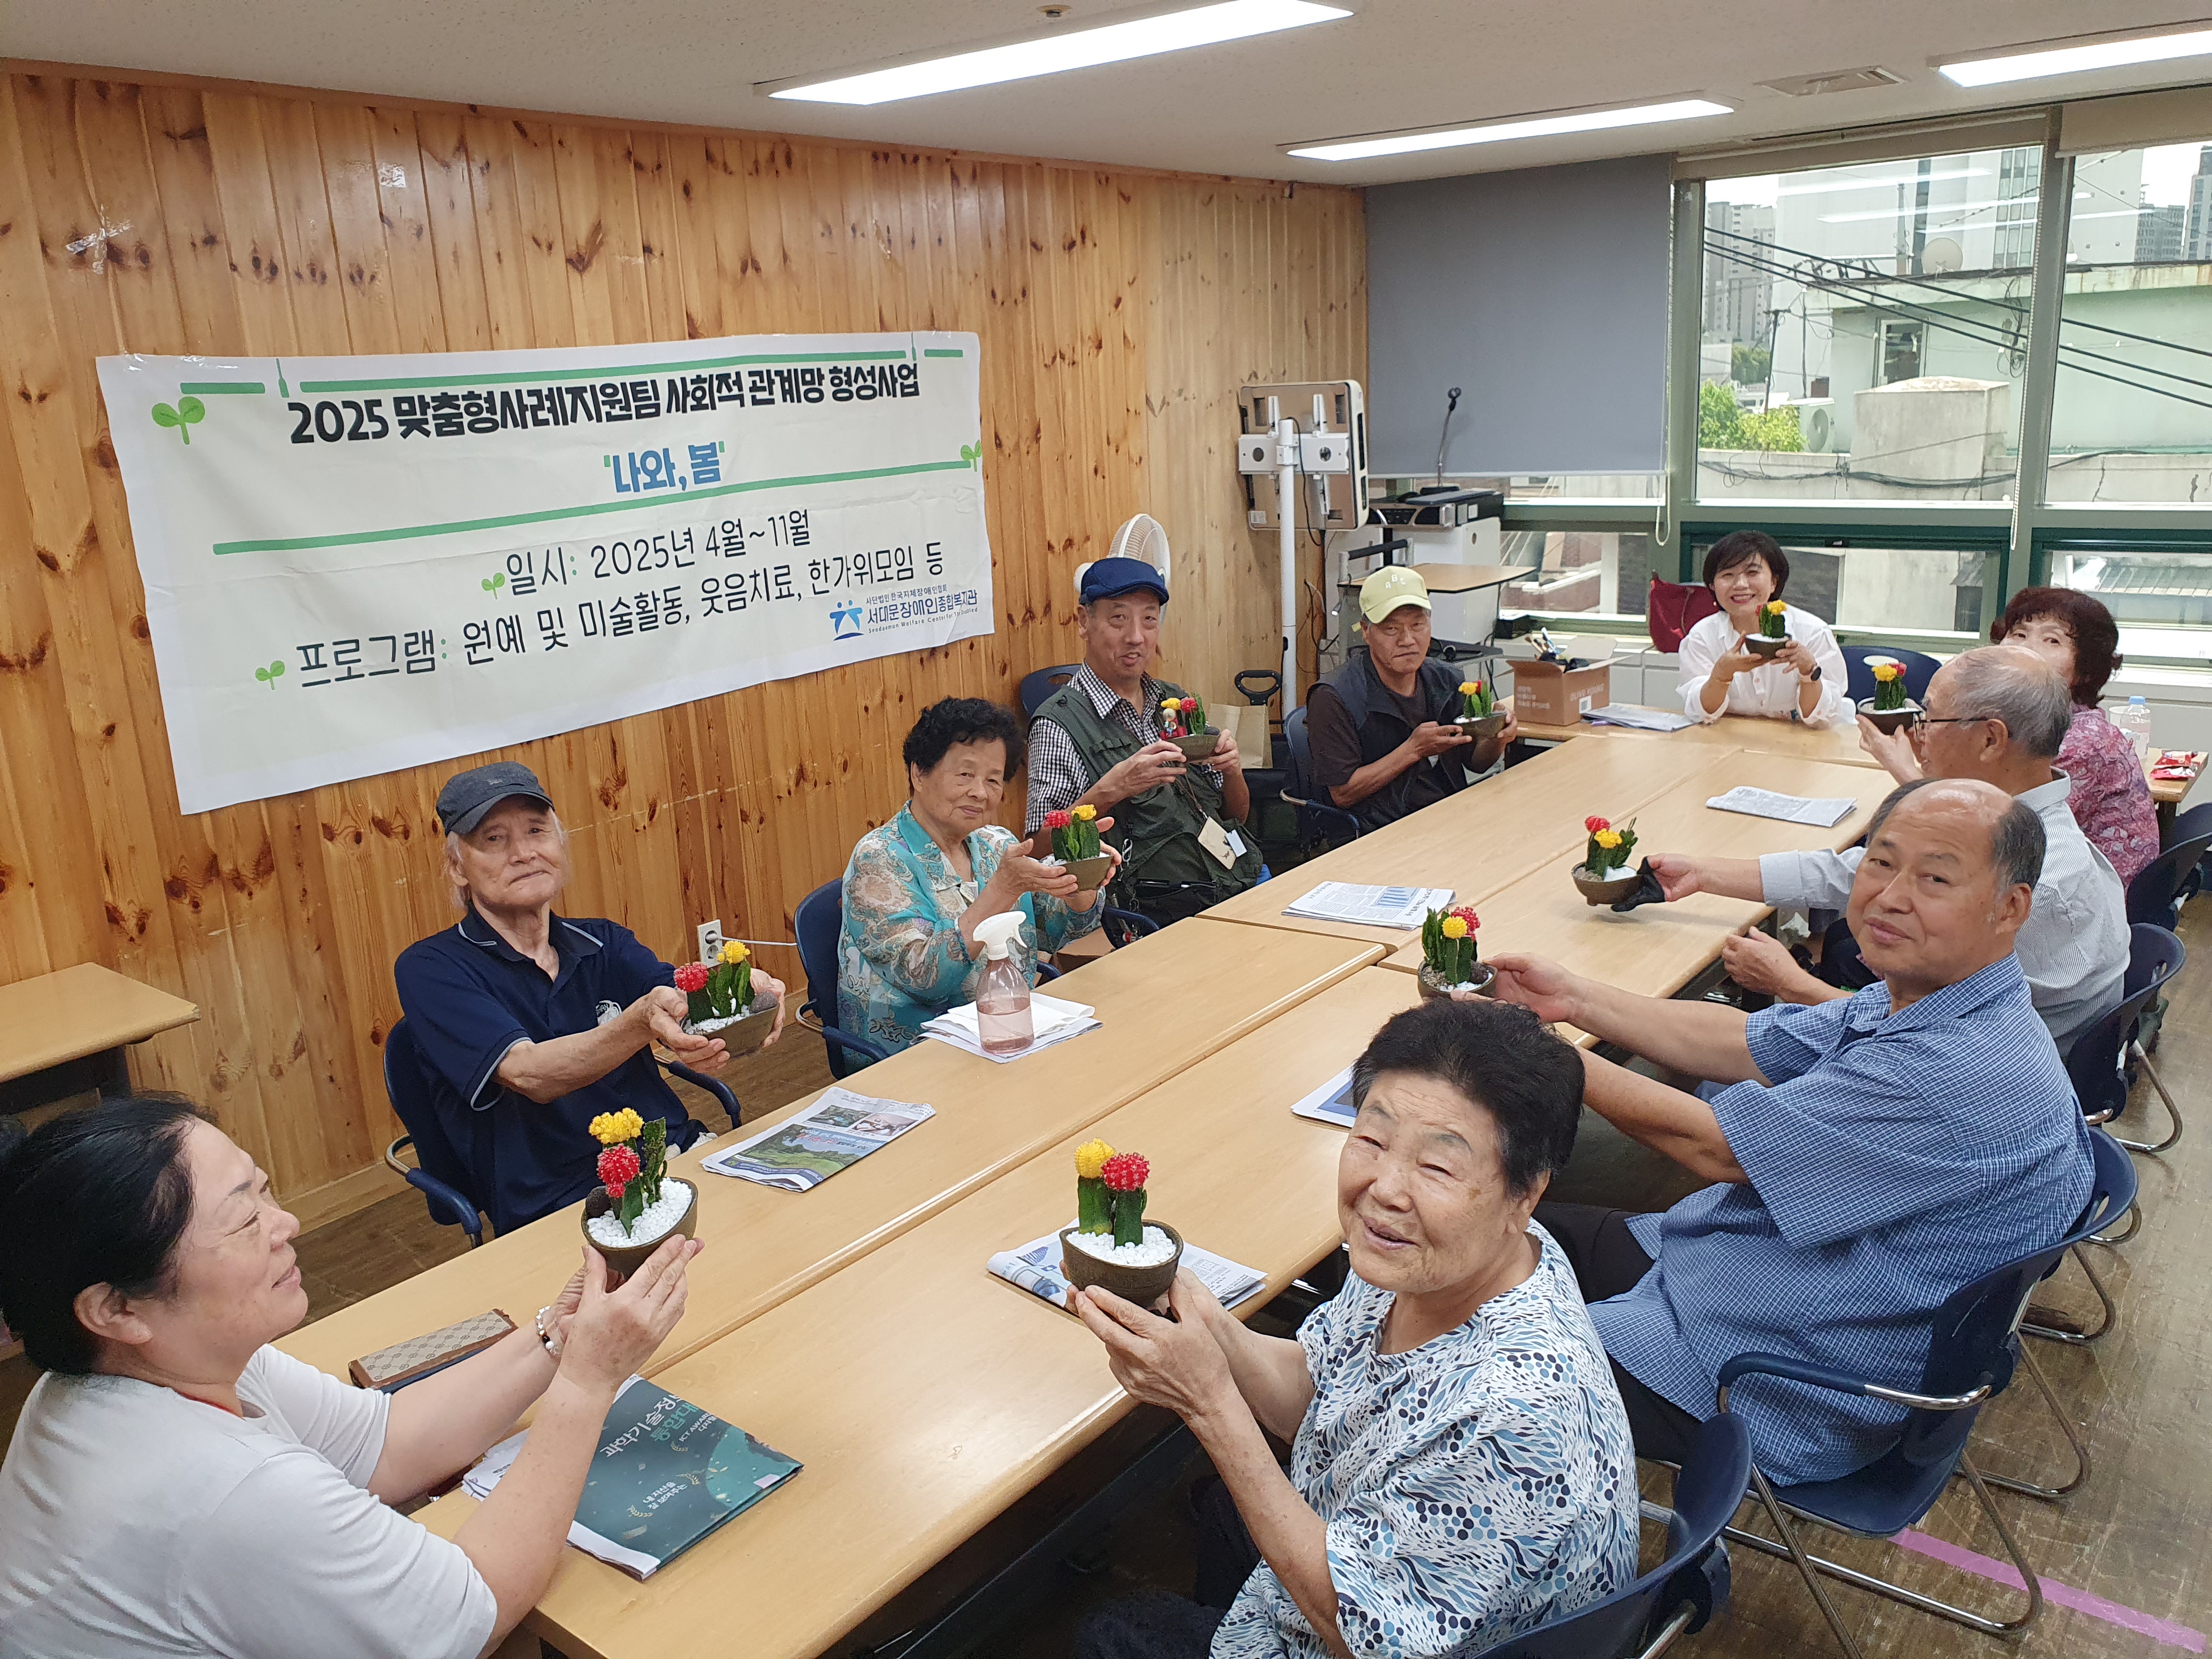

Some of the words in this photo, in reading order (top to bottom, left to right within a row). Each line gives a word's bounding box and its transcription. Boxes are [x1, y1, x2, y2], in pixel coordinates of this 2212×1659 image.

[287, 399, 390, 444] 2025
[393, 380, 660, 439] 맞춤형사례지원팀
[667, 371, 745, 414] 사회적
[748, 367, 826, 407] 관계망
[828, 363, 920, 402] 형성사업
[507, 547, 577, 595] 일시:
[591, 527, 695, 578] 2025년
[706, 509, 810, 557] 4월~11월
[296, 629, 447, 687] 프로그램:
[464, 614, 526, 665] 원예
[537, 607, 568, 651] 및
[579, 586, 690, 637] 미술활동,
[702, 565, 802, 617] 웃음치료,
[808, 546, 913, 595] 한가위모임
[927, 542, 943, 575] 등
[866, 593, 890, 605] 사단법인
